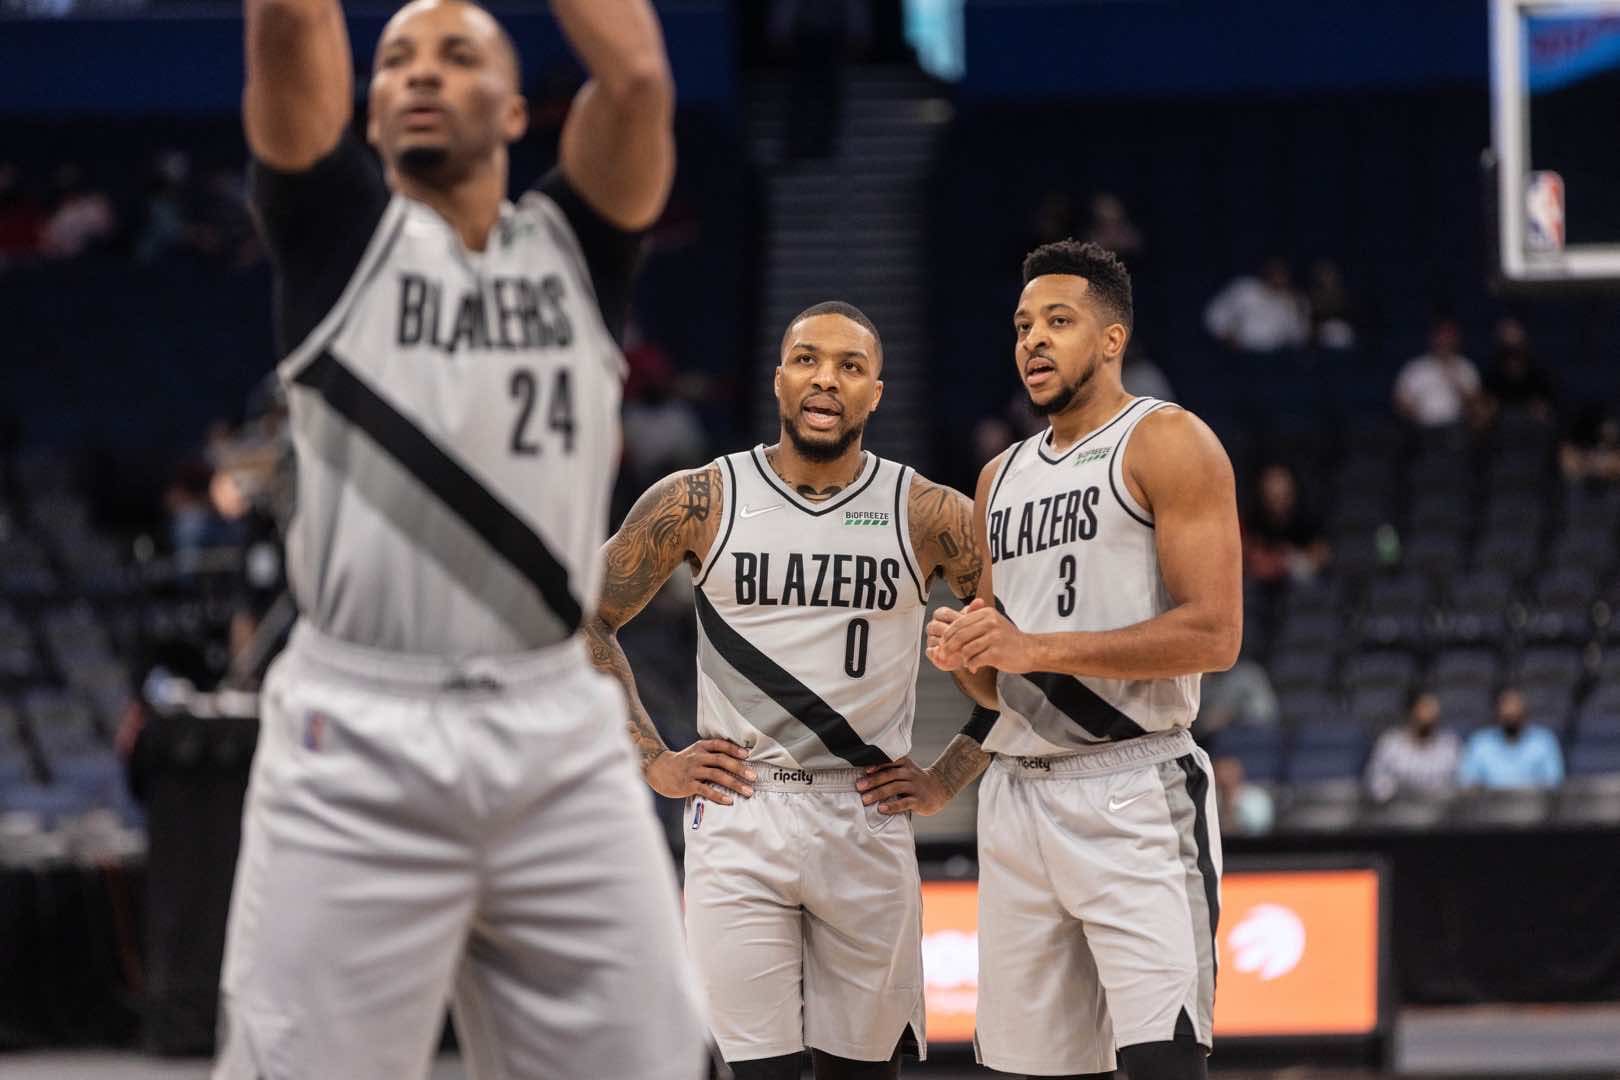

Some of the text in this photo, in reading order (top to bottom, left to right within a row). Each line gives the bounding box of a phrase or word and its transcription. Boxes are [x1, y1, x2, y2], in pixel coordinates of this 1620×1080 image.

[510, 366, 580, 457] 24
[989, 486, 1101, 565] BLAZERS
[731, 552, 900, 611] BLAZERS
[1057, 554, 1077, 617] 3
[845, 617, 869, 679] 0
[773, 768, 814, 785] ripcity
